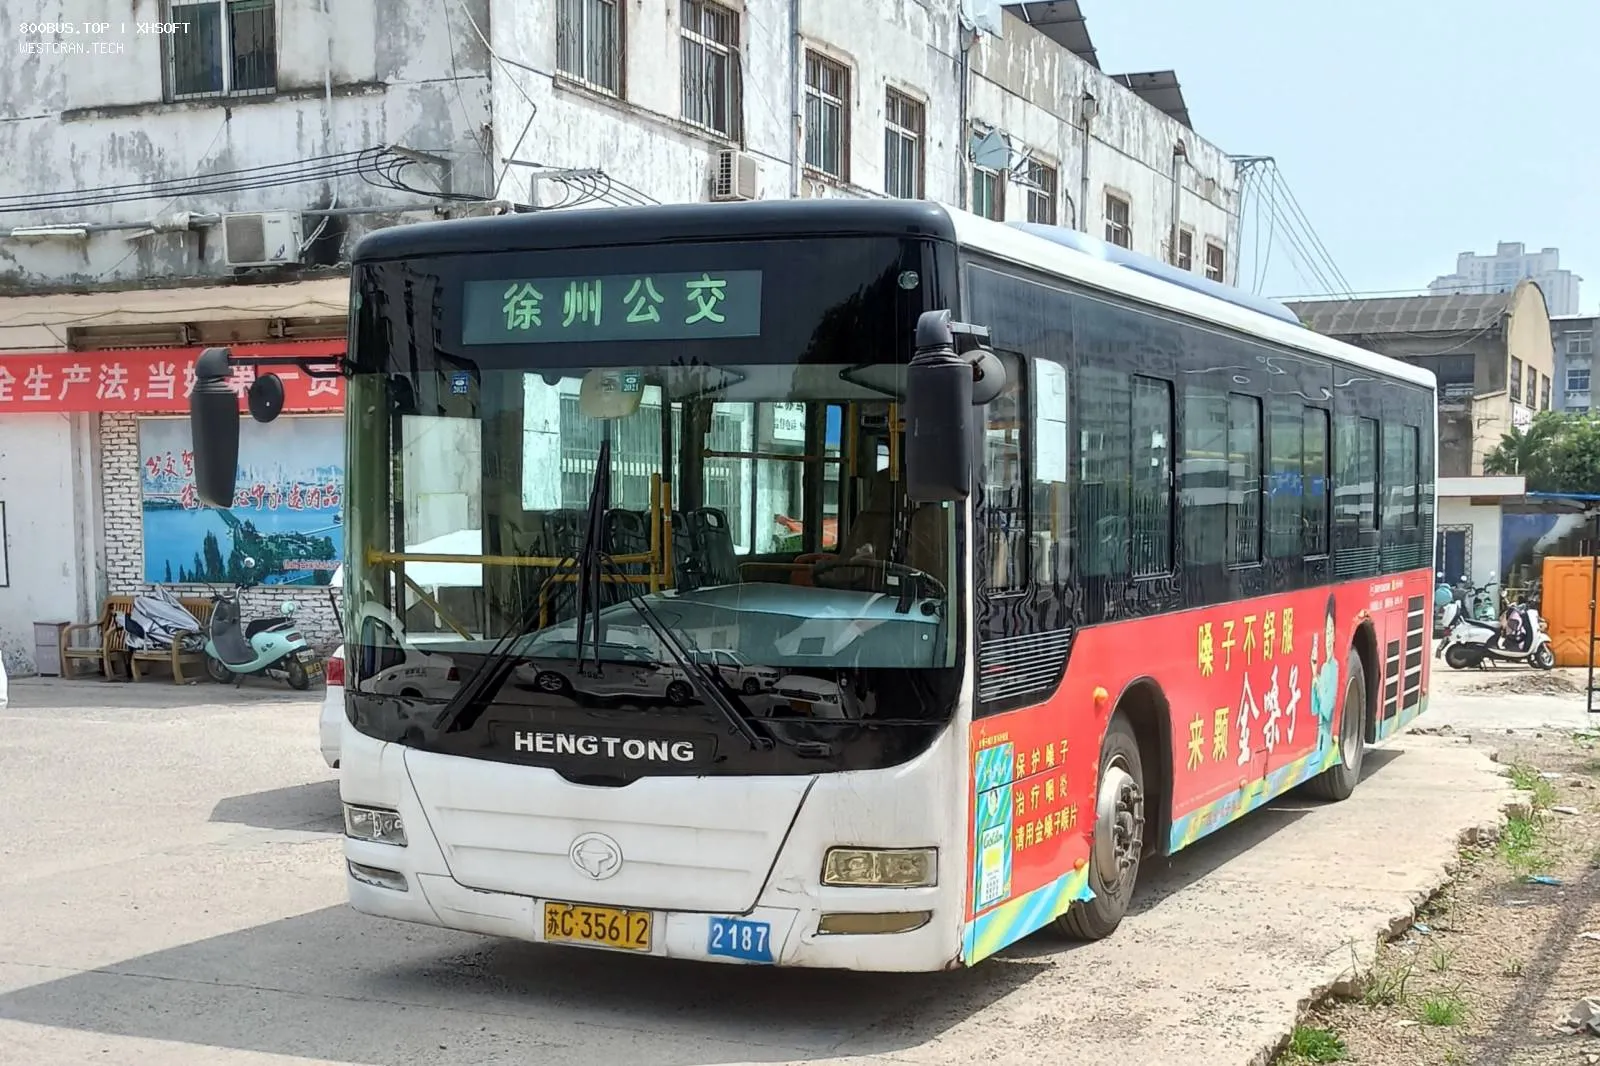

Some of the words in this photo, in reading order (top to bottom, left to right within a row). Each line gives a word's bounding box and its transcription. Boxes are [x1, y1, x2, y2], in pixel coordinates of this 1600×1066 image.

[502, 273, 728, 330] 徐州公交
[1198, 607, 1294, 677] 嗓子不舒服
[514, 731, 694, 762] HENGTONG
[1015, 739, 1069, 779] 保护嗓子
[1015, 773, 1068, 816] 治疗咽炎
[711, 923, 768, 953] 2187
